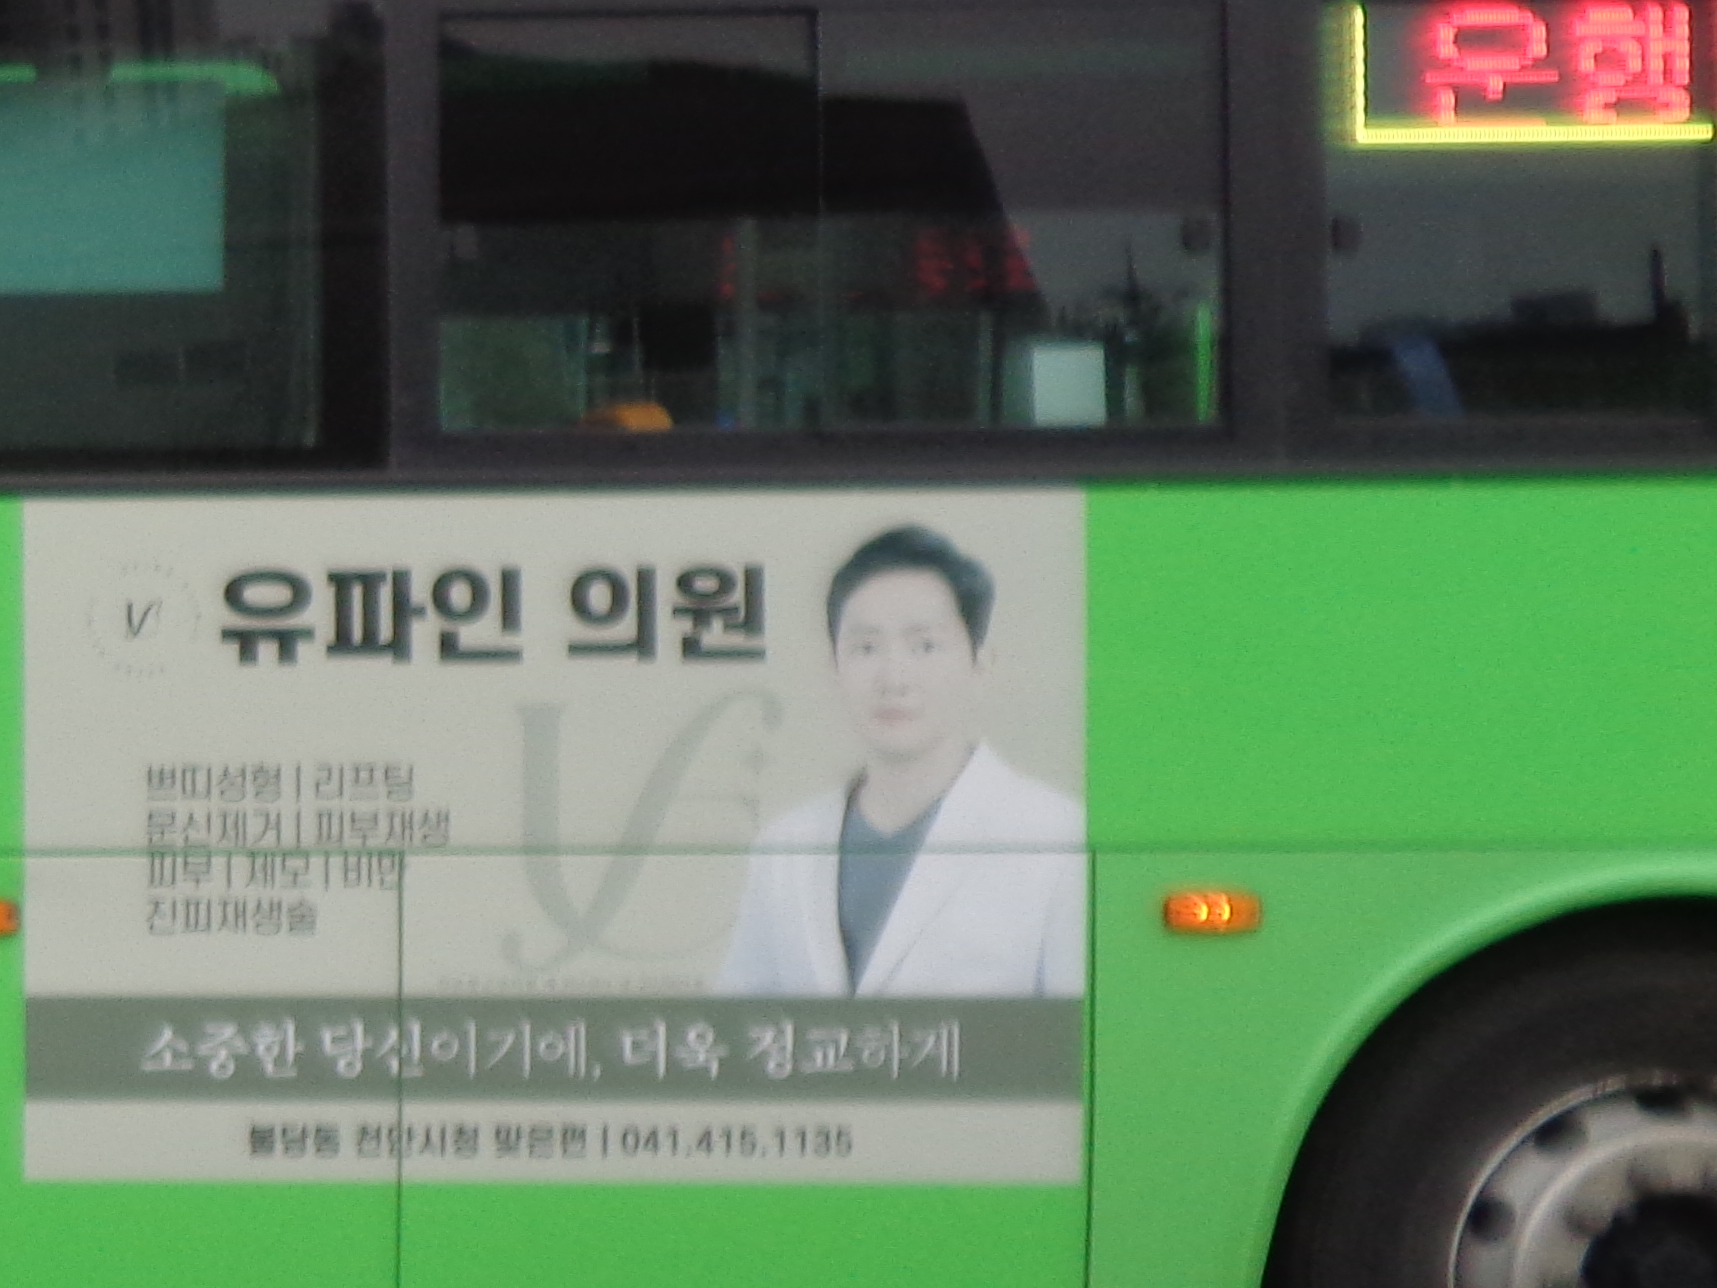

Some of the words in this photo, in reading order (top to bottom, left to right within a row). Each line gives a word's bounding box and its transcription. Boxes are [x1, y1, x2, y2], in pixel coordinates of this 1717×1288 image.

[217, 564, 527, 667] 유파인
[566, 564, 768, 667] 의원
[315, 762, 414, 803] 리프팅
[316, 808, 451, 849] 피부재생
[140, 1017, 304, 1080] 소중한
[621, 1017, 731, 1081] 더욱
[745, 1017, 961, 1082] 정교하게
